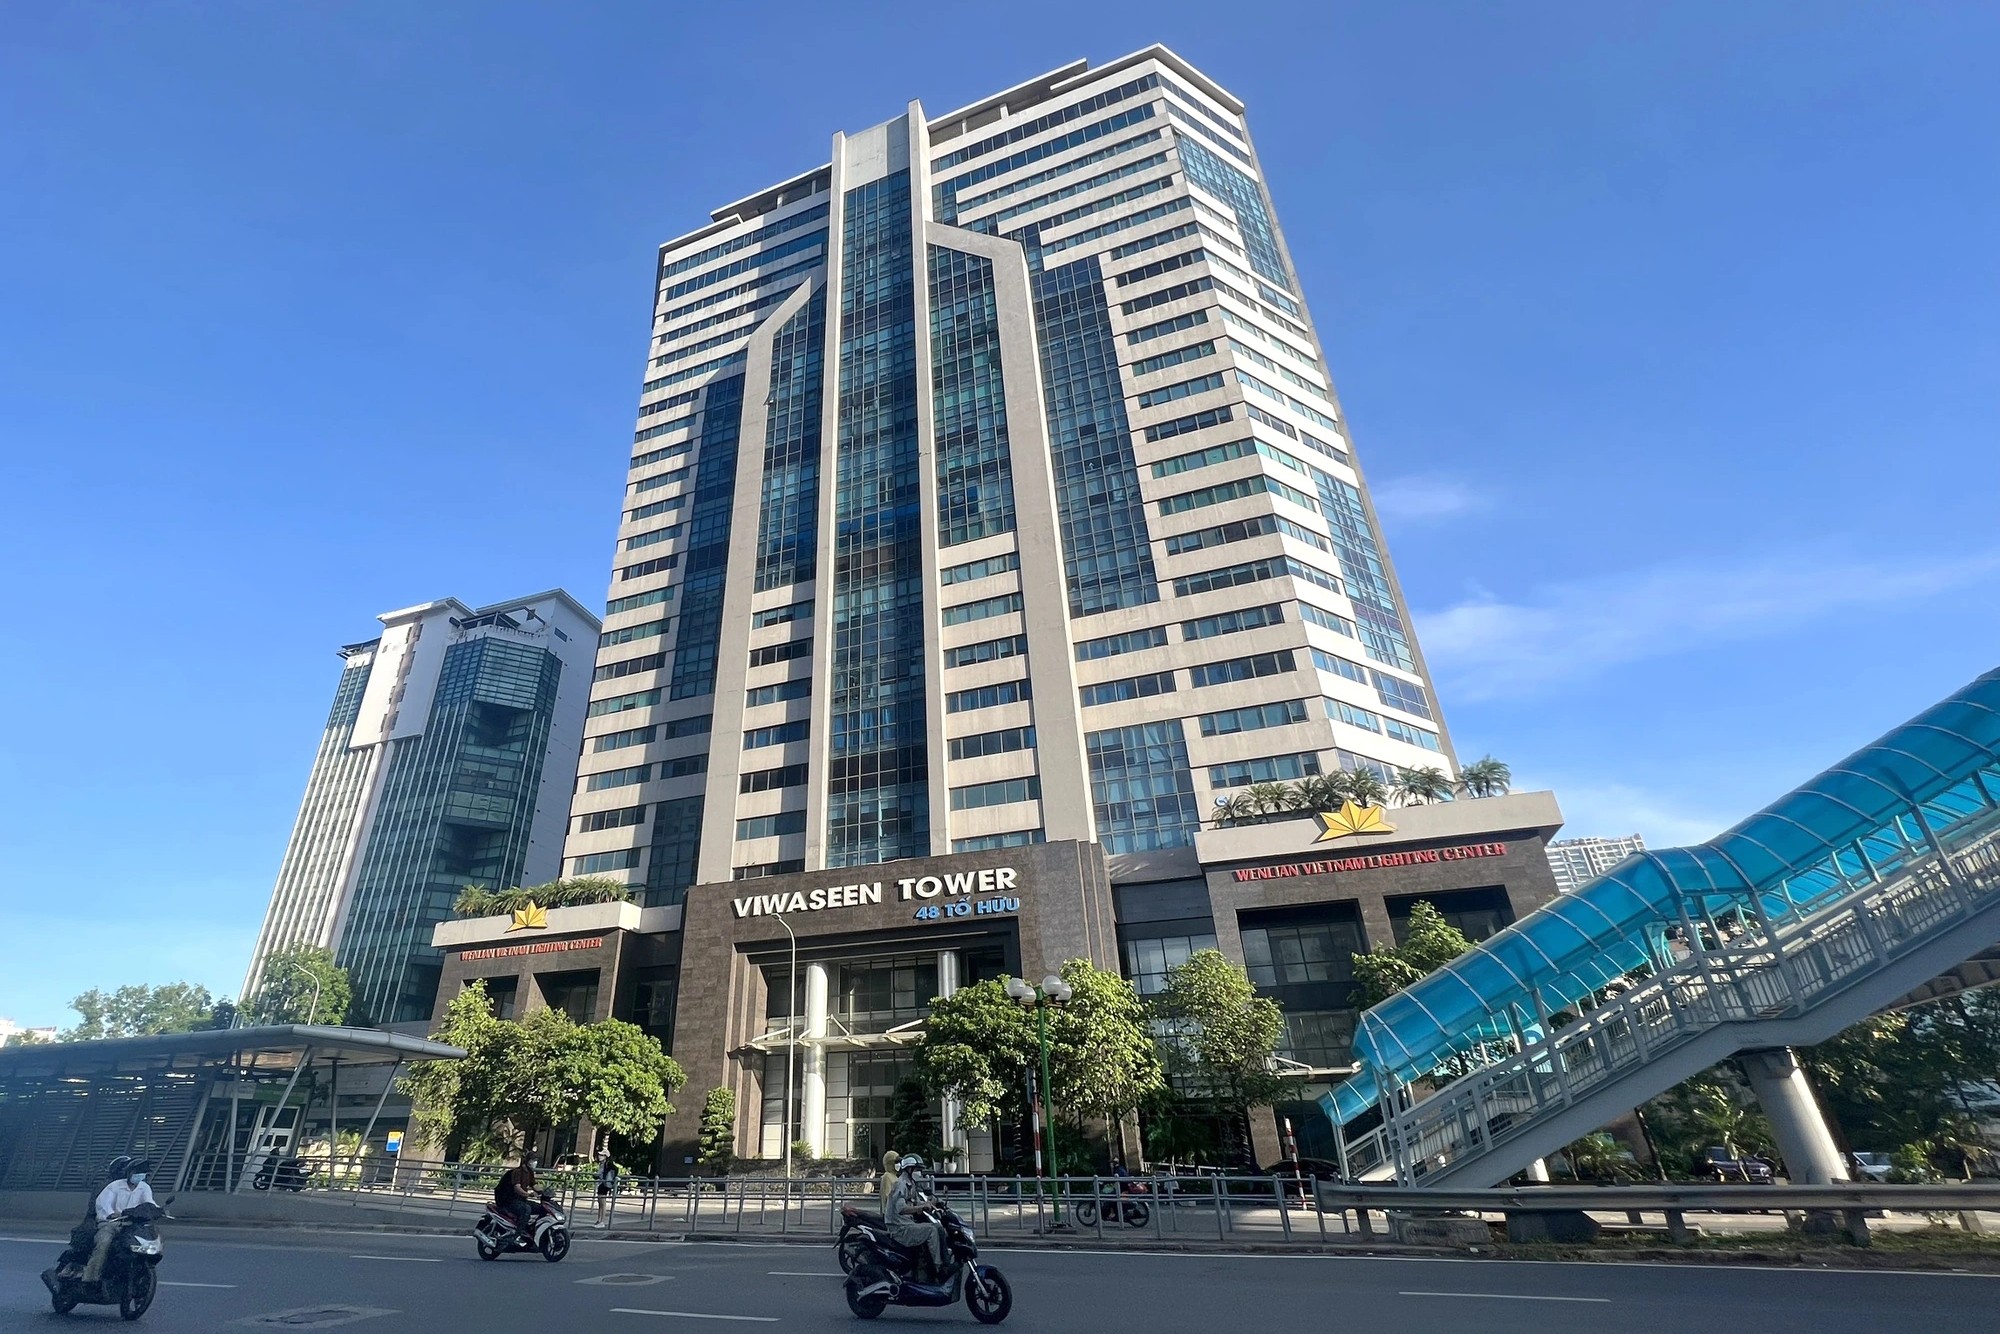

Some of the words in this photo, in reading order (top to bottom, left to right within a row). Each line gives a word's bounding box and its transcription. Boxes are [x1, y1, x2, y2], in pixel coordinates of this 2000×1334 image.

[1235, 864, 1299, 881] WENLIAN
[1301, 856, 1366, 874] VIETNAM
[1366, 849, 1439, 868] LIGHTING
[1442, 842, 1507, 860] CENTER
[733, 881, 882, 918] VIWASEEN
[897, 867, 1018, 900] TOWER
[915, 905, 940, 920] 48
[944, 896, 971, 917] TỐ
[460, 948, 495, 961] WENLIAN
[496, 945, 529, 957] VIETNAM
[529, 940, 568, 953] LIGHTING
[569, 937, 602, 950] CENTER
